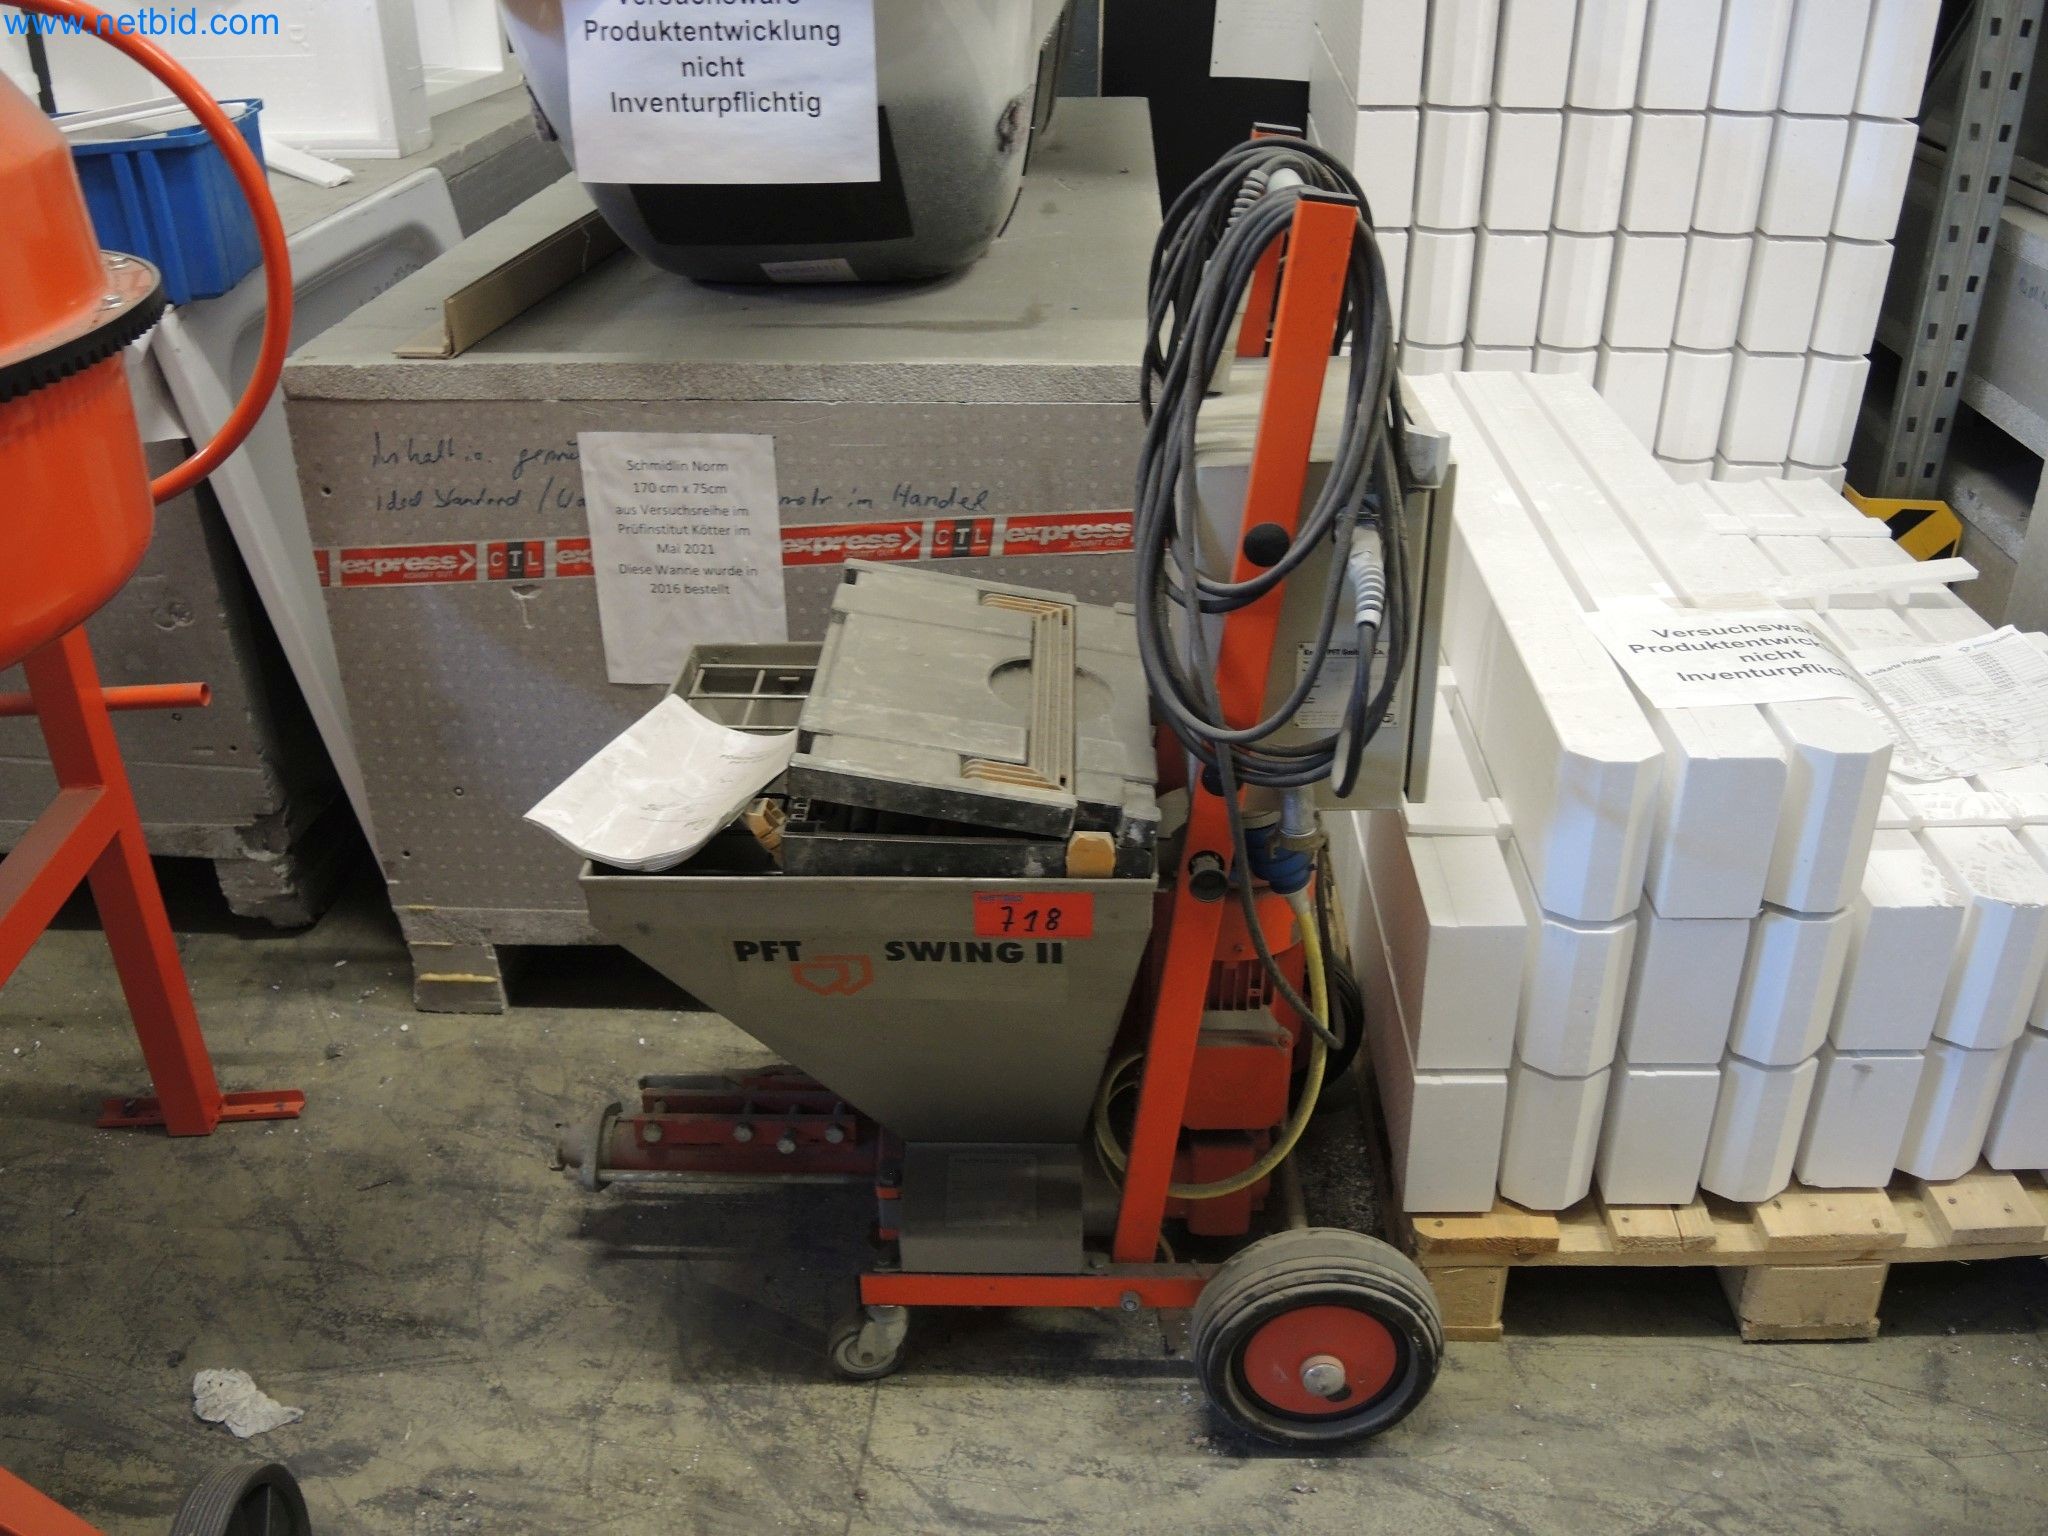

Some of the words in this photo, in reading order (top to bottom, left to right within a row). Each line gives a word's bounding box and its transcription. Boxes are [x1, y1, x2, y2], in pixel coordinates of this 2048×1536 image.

[584, 19, 841, 46] Produktentwicklung
[681, 56, 745, 77] nicht
[611, 91, 822, 117] Inventurpflichtig
[626, 459, 688, 472] Schmidlin
[693, 460, 728, 472] Norm
[633, 482, 657, 494] 170
[660, 484, 678, 494] cm
[682, 485, 689, 494] x
[693, 482, 727, 494] 75cm
[893, 484, 989, 511] Handel
[615, 505, 637, 515] aus
[640, 504, 729, 517] Versuchsreihe
[732, 506, 749, 517] im
[618, 523, 689, 535] Prüfinstitut
[692, 524, 731, 536] Kötter
[734, 525, 751, 536] im
[340, 555, 458, 577] express
[490, 551, 541, 567] CTL
[783, 532, 902, 556] express
[935, 526, 986, 545] CTL
[1006, 521, 1133, 546] express
[656, 543, 681, 554] Mai
[684, 543, 716, 555] 2021
[619, 563, 651, 575] Diese
[655, 564, 699, 575] Wanne
[703, 564, 743, 577] wurde
[746, 565, 758, 576] in
[650, 583, 681, 594] 2016
[684, 583, 731, 595] bestellt
[1738, 649, 1806, 663] nicht
[1000, 905, 1062, 932] 718
[733, 940, 803, 963] PFT
[884, 940, 1025, 965] SWING
[1036, 942, 1065, 965] II
